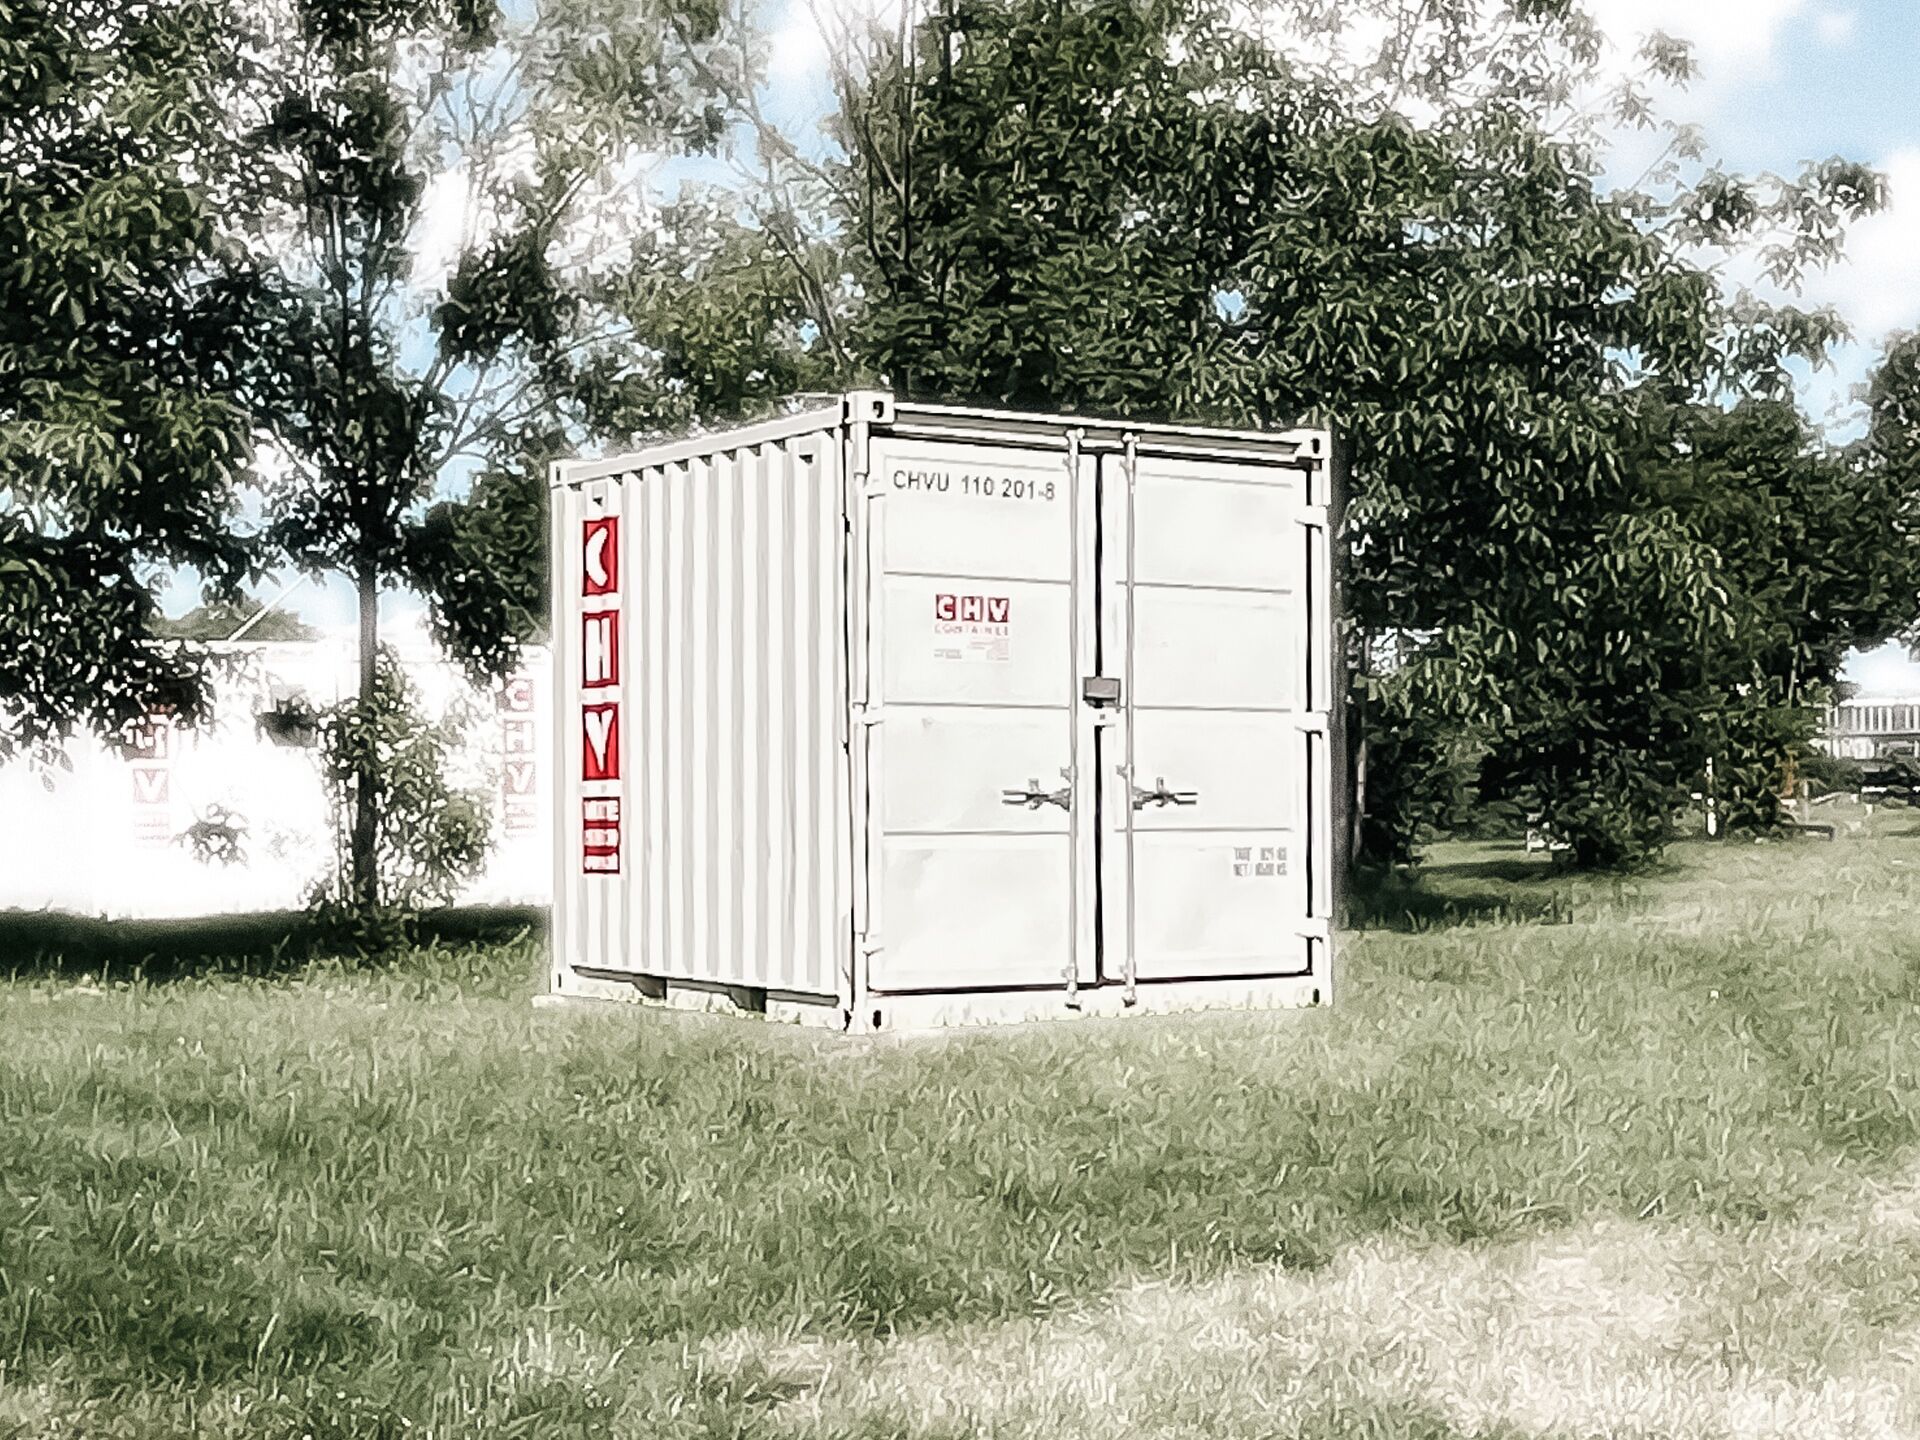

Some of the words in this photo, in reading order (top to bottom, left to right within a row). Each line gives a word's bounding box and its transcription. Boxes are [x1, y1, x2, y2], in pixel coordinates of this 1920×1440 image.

[893, 470, 949, 492] CHVU
[961, 475, 994, 496] 110
[1002, 478, 1055, 502] 201-8
[936, 594, 1009, 623] CHV
